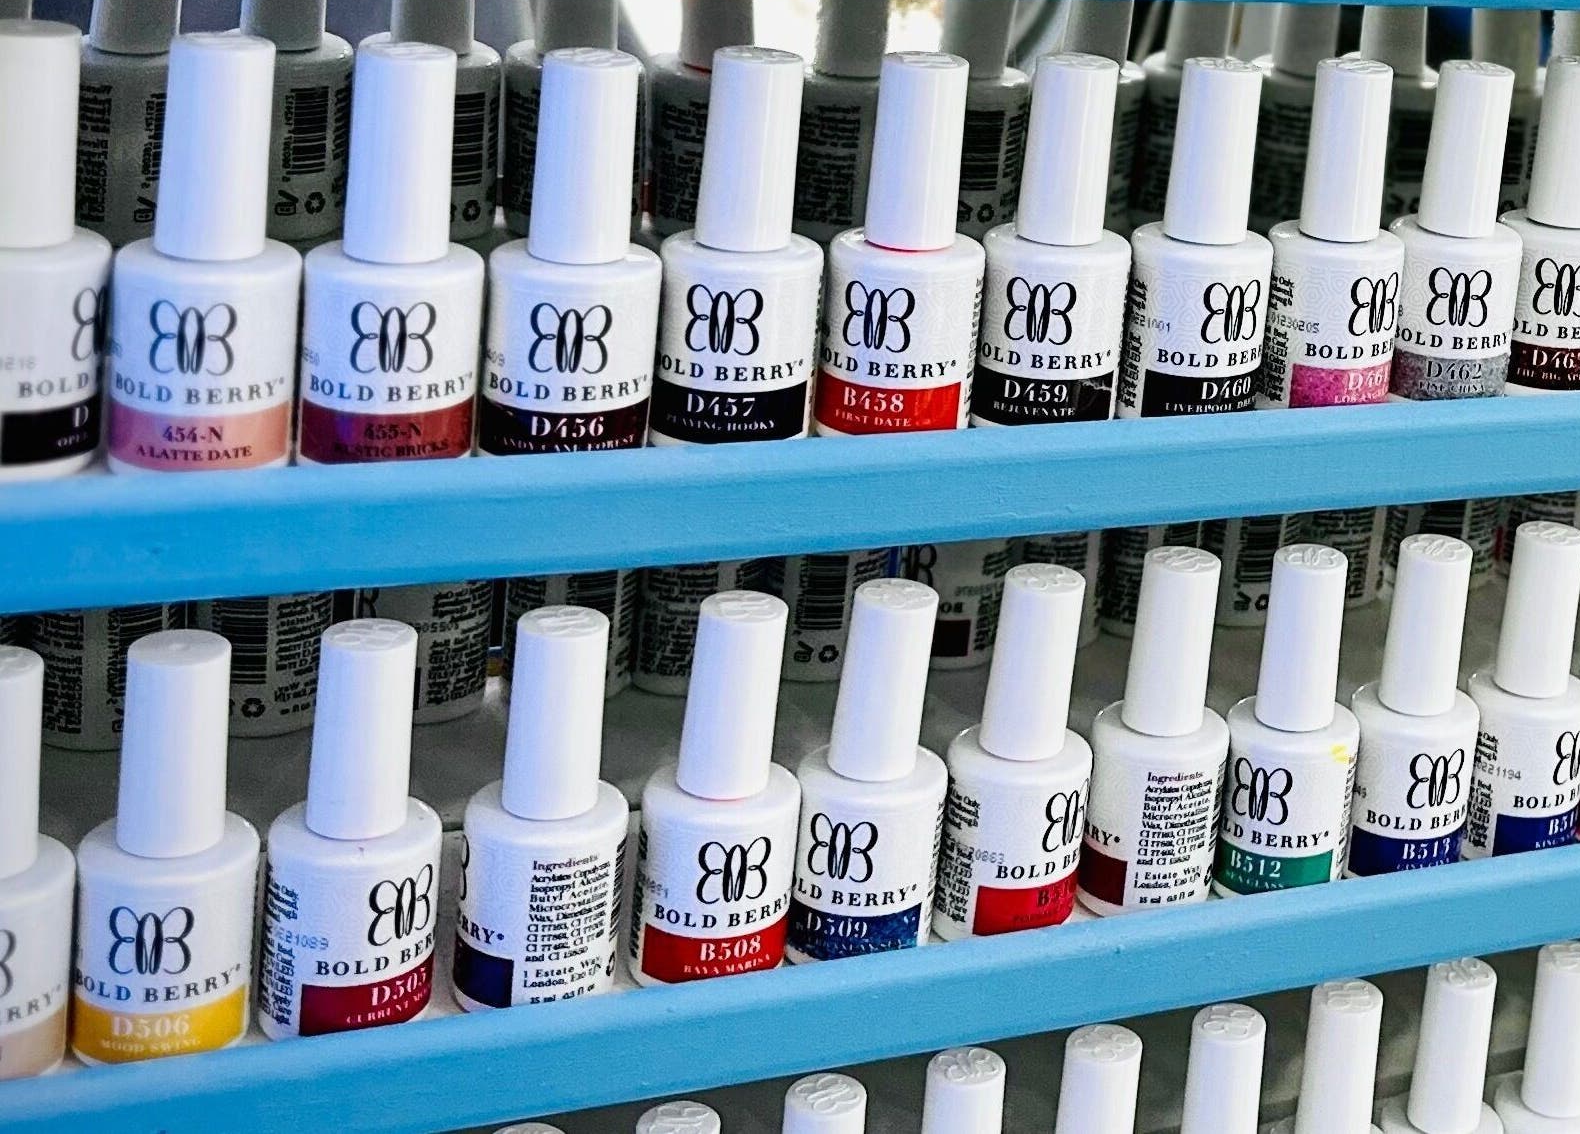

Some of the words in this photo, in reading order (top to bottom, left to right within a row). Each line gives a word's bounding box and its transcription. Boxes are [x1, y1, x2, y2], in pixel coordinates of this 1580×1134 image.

[1030, 352, 1105, 371] BERRY
[1157, 348, 1219, 369] BOLD
[1305, 342, 1364, 361] BOLD
[715, 362, 797, 383] BERRY
[867, 361, 949, 381] BERRY
[1426, 360, 1482, 382] D462
[18, 372, 90, 400] BOLD
[115, 372, 173, 403] BOLD
[310, 374, 375, 403] BOLD
[489, 372, 551, 402] BOLD
[1003, 379, 1068, 404] D459
[1201, 378, 1251, 402] D460
[687, 392, 756, 418] D457
[842, 386, 905, 414] B458
[531, 415, 605, 439] D456
[834, 409, 869, 427] FIRST
[874, 416, 912, 428] DATE
[162, 424, 224, 444] 454-N
[148, 448, 204, 462] LATTE
[208, 445, 252, 461] DATE
[1513, 793, 1565, 810] BOLD
[1366, 809, 1422, 831] BOLD
[1251, 831, 1321, 850] BERRY
[1402, 837, 1451, 861] B513
[995, 860, 1056, 881] BOLD
[1230, 848, 1281, 879] B512
[530, 892, 563, 904] Butyl
[654, 902, 717, 930] BOLD
[806, 912, 868, 939] D509
[699, 935, 762, 963] B508
[315, 956, 390, 977] BOLD
[536, 966, 574, 978] Estate
[371, 968, 428, 1008] D505
[111, 1016, 191, 1038] D506
